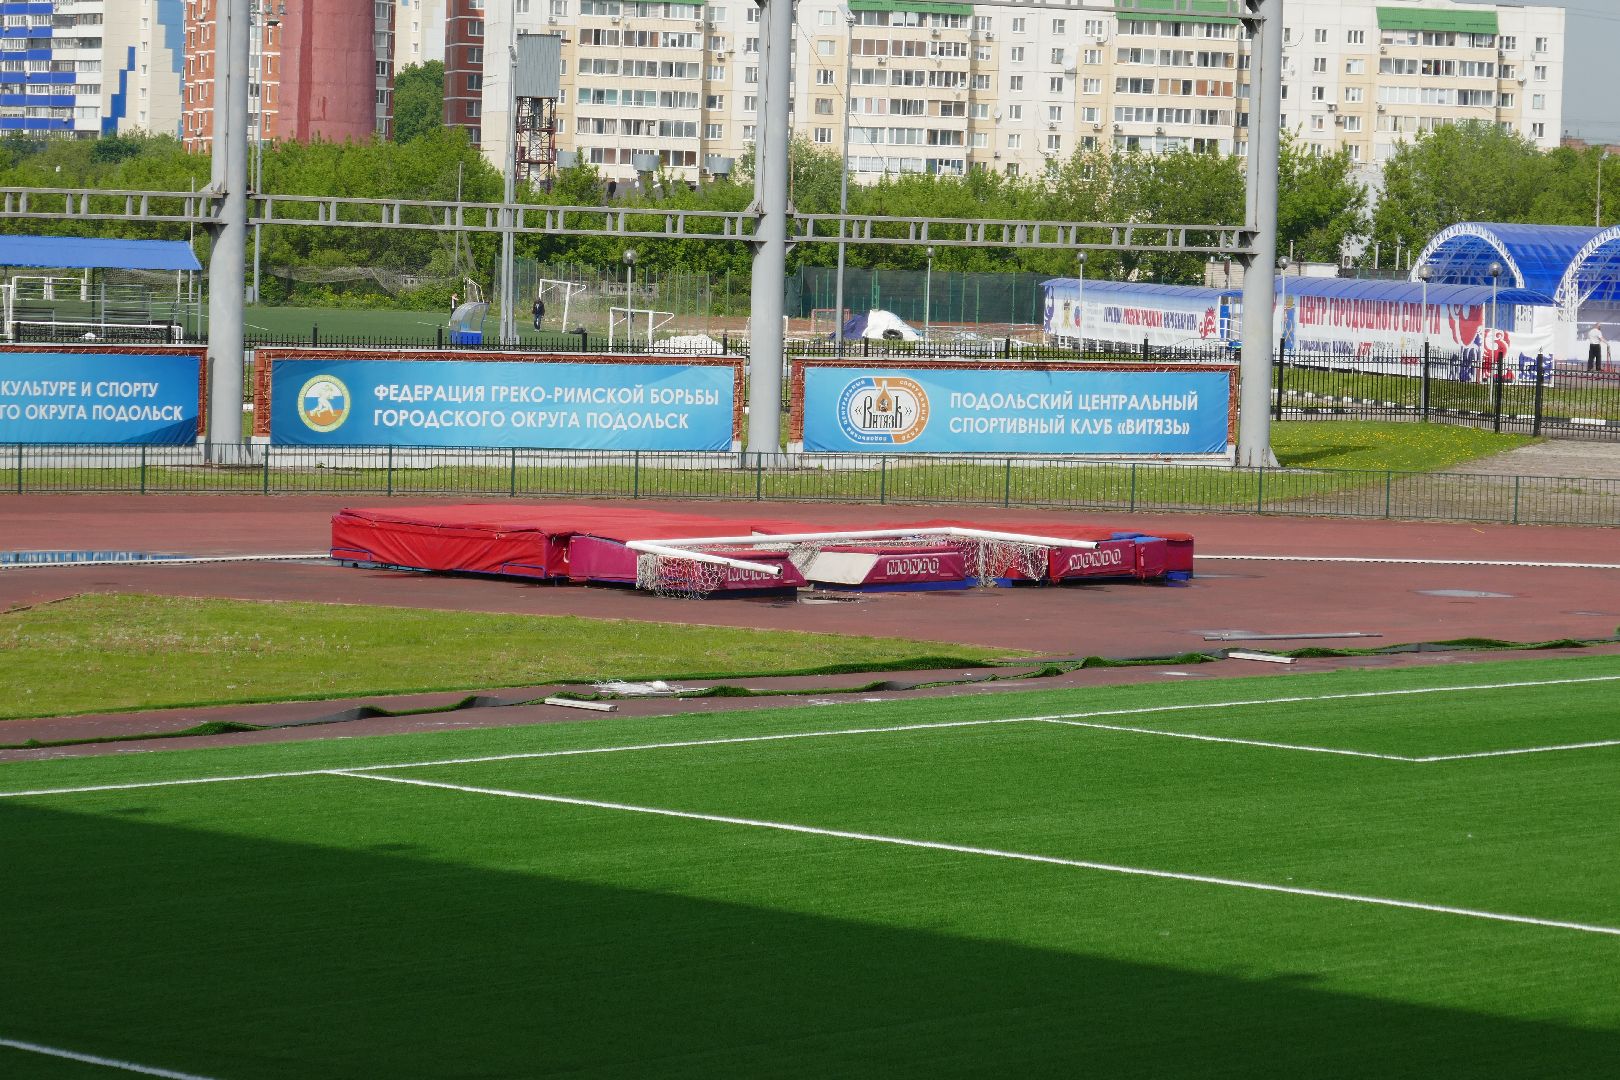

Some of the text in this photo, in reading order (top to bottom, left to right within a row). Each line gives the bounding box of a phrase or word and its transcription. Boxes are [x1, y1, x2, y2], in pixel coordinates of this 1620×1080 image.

[1, 381, 159, 398] КУЛЬТУРЕ И СПОРТУ
[373, 384, 719, 406] ФЕДЕРАЦИЯ ГРЕКО-РИМСКОЙ БОРЬБЫ
[950, 390, 1199, 411] ПОДОЛЬСКИЙ ЦЕНТРАЛЬНЫЙ
[25, 404, 88, 420] ОКРУГА
[92, 405, 184, 422] ПОДОЛЬСК
[373, 409, 689, 431] ГОРОДСКОГО ОКРУГА ПОДОЛЬСК
[950, 415, 1190, 435] СПОРТИВНЫЙ КЛУБ «ВИТЯЗЬ»
[887, 558, 940, 576] MONDO
[1069, 549, 1122, 571] MONDO
